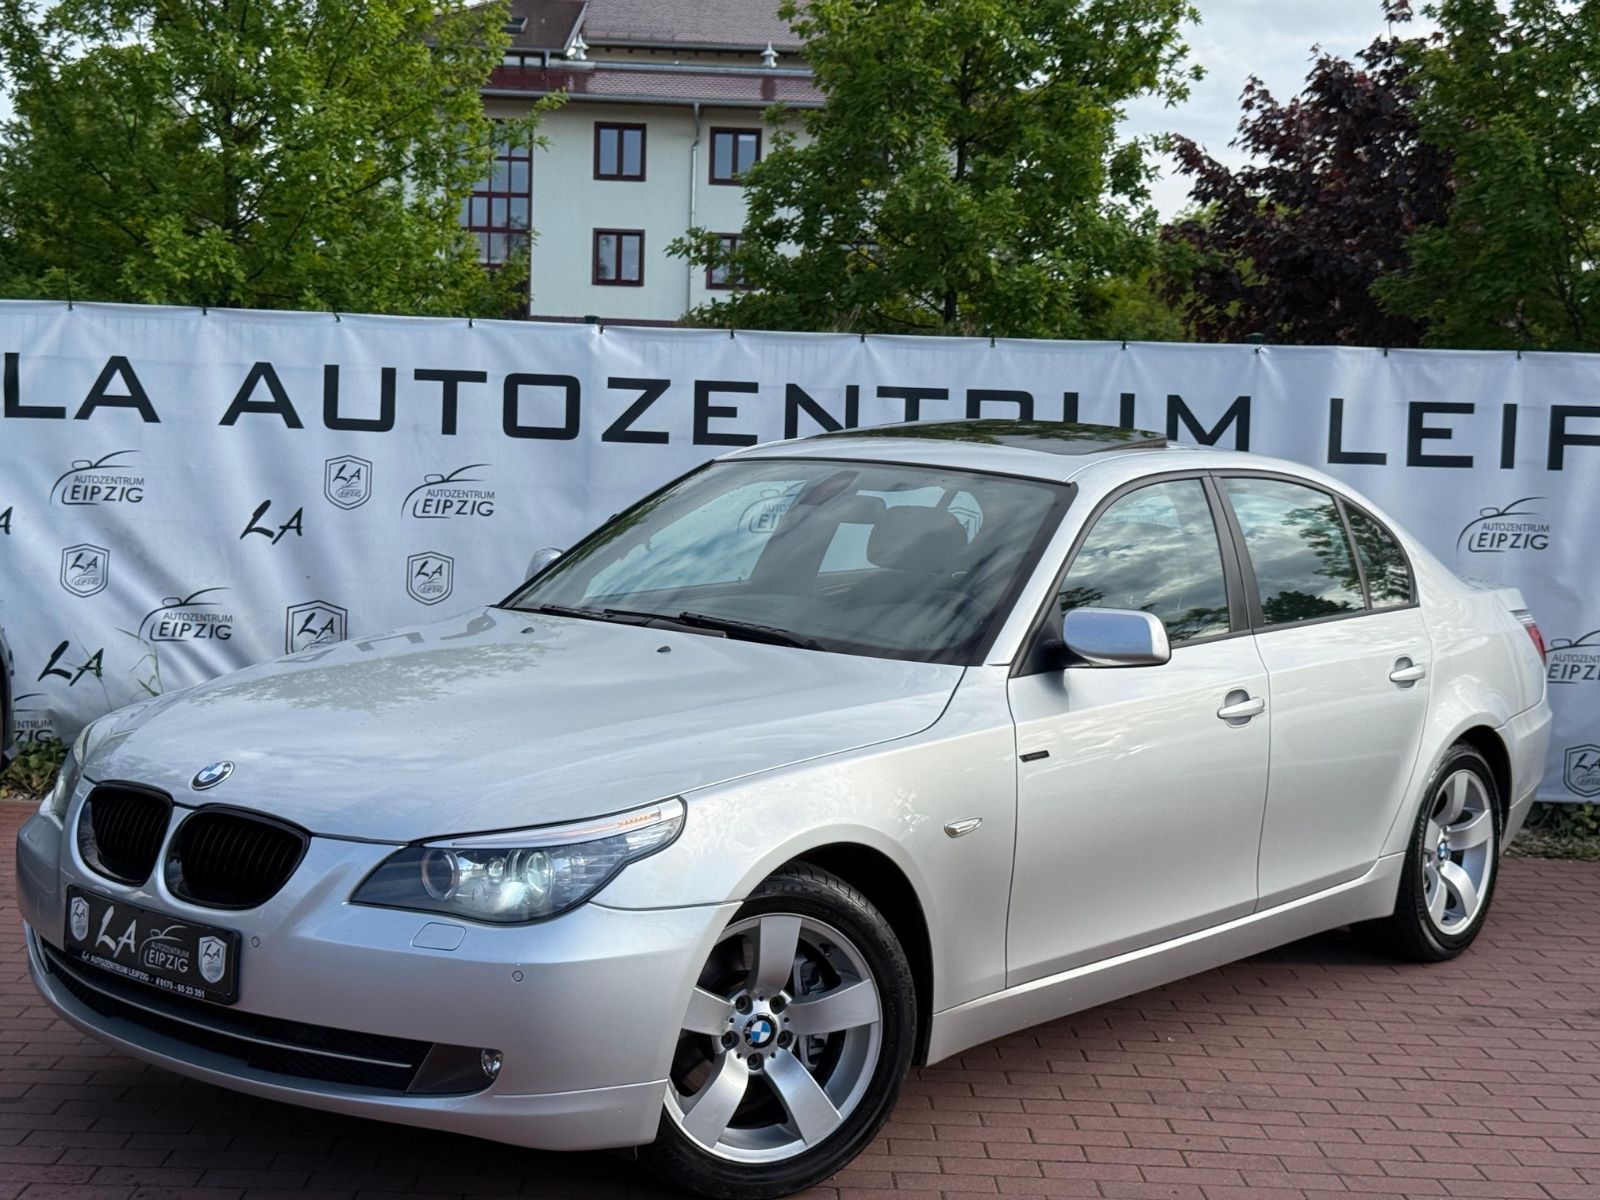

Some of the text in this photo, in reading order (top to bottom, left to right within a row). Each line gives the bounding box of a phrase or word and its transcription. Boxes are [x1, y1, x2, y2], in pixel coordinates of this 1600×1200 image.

[3, 352, 161, 424] LA
[73, 474, 145, 486] AUTOZENTRUM
[332, 463, 361, 484] LA
[426, 488, 495, 500] AUTOZENTRUM
[240, 500, 303, 545] LA
[1481, 522, 1550, 533] AUTOZENTRUM
[69, 552, 98, 572] LA
[414, 559, 443, 580] LA
[163, 611, 233, 624] AUTOZENTRUM
[296, 611, 336, 640] LA
[38, 639, 104, 687] LA
[95, 905, 137, 958] LA
[151, 941, 190, 958] AUTOZENTRUM
[203, 943, 220, 960] LA
[90, 955, 128, 975] AUTOZENTRUM
[128, 967, 150, 981] LEIPZIG
